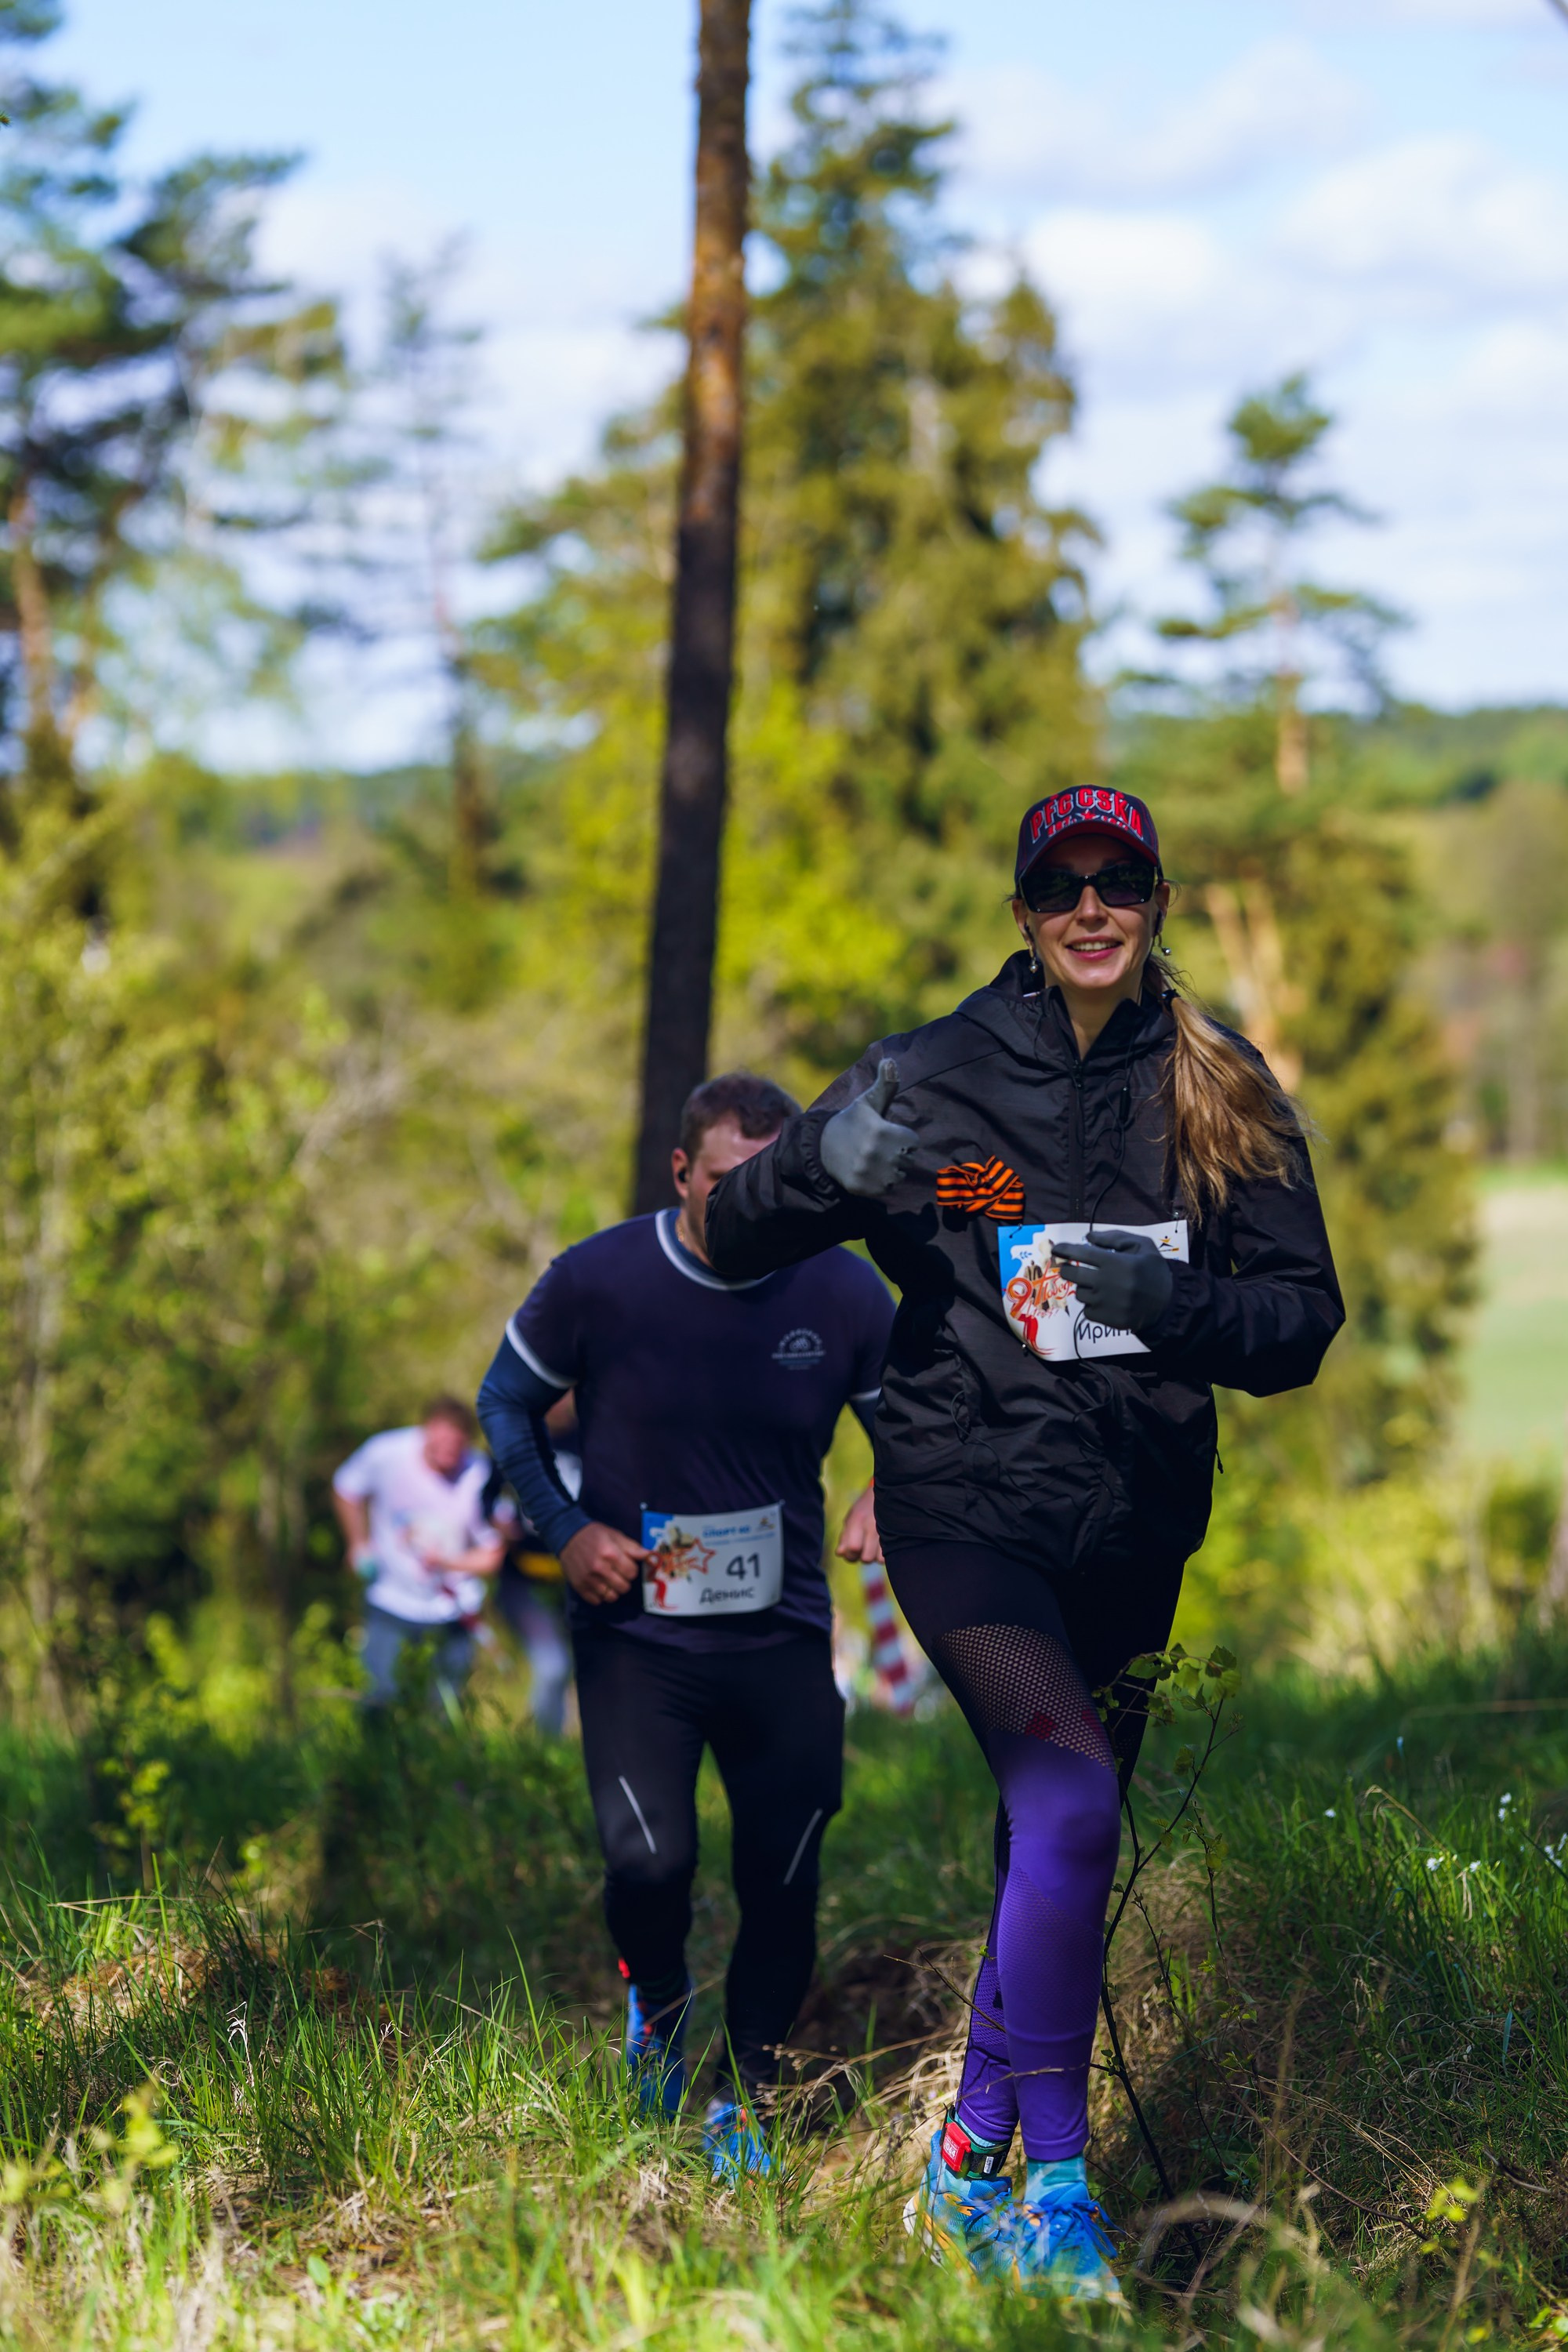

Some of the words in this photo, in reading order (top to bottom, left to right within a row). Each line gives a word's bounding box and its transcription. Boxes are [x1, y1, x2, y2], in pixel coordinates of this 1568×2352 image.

[1029, 793, 1074, 844] PFC
[1076, 788, 1144, 841] CSKA
[1078, 1323, 1132, 1344] Ири
[726, 1552, 760, 1581] 41
[699, 1586, 755, 1606] Денис
